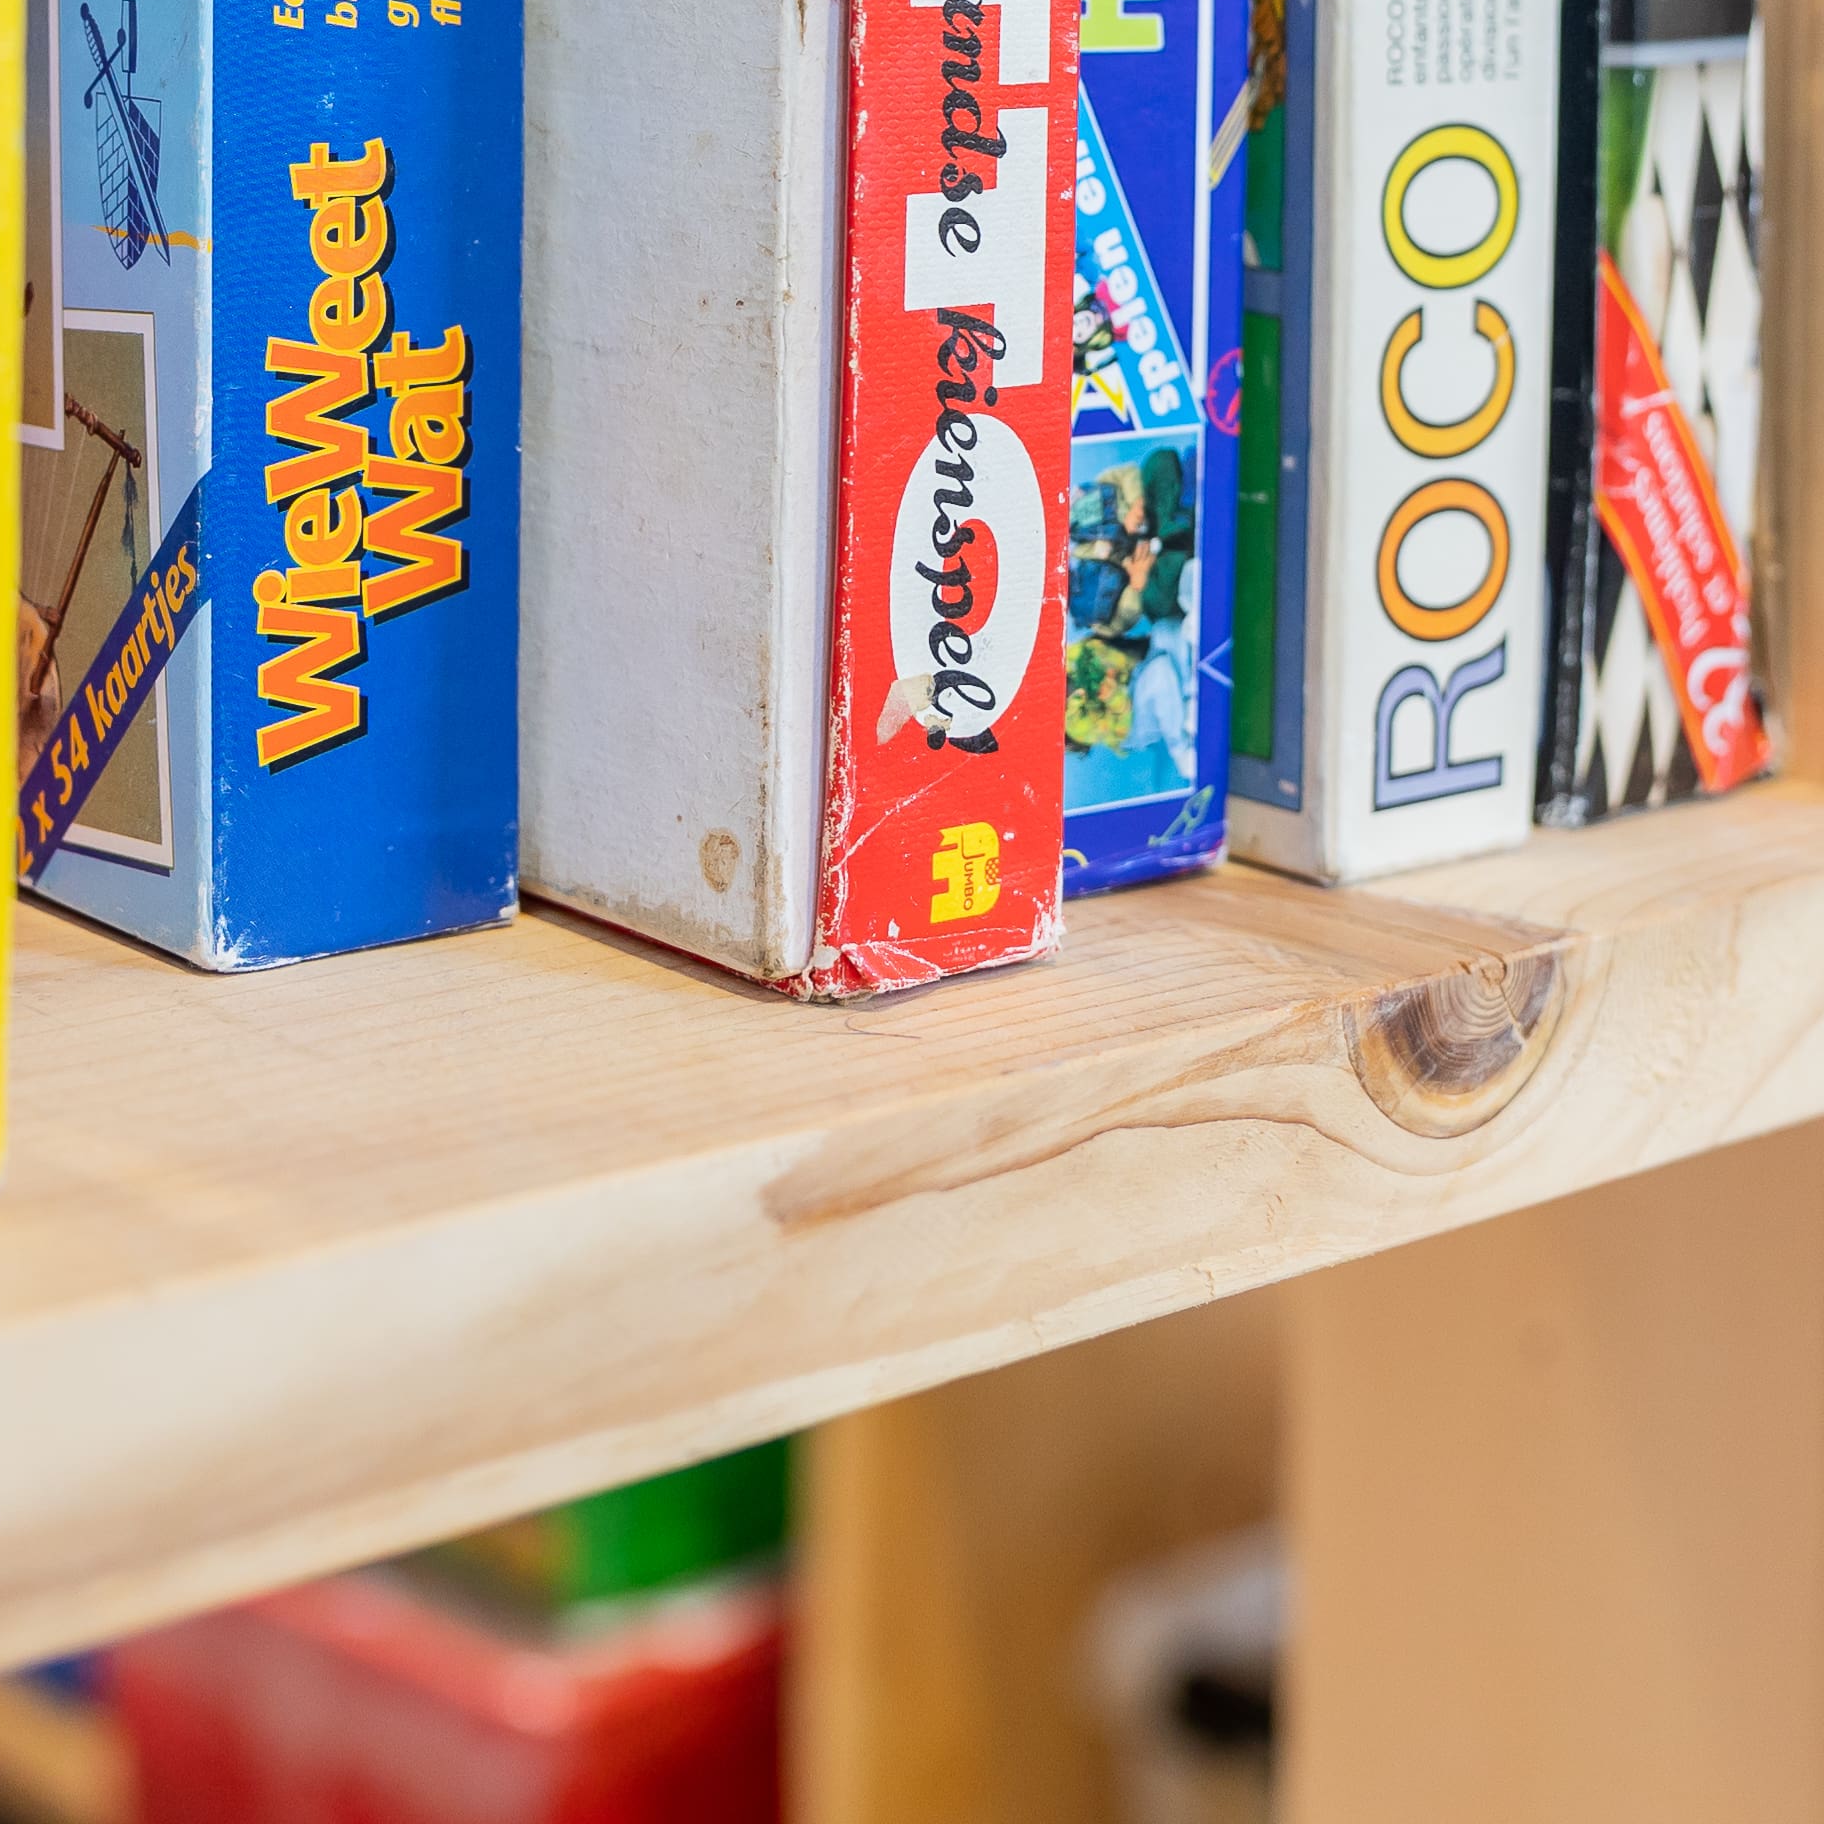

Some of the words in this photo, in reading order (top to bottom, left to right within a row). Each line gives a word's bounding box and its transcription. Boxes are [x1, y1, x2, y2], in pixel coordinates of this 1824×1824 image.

[1091, 227, 1183, 416] spelen
[1372, 122, 1520, 813] ROCO
[362, 324, 469, 620] Wat
[915, 307, 1007, 756] kienspel!
[32, 796, 55, 834] x
[50, 713, 90, 808] 54
[90, 541, 198, 744] kaartjes
[961, 831, 986, 911] JUMBO
